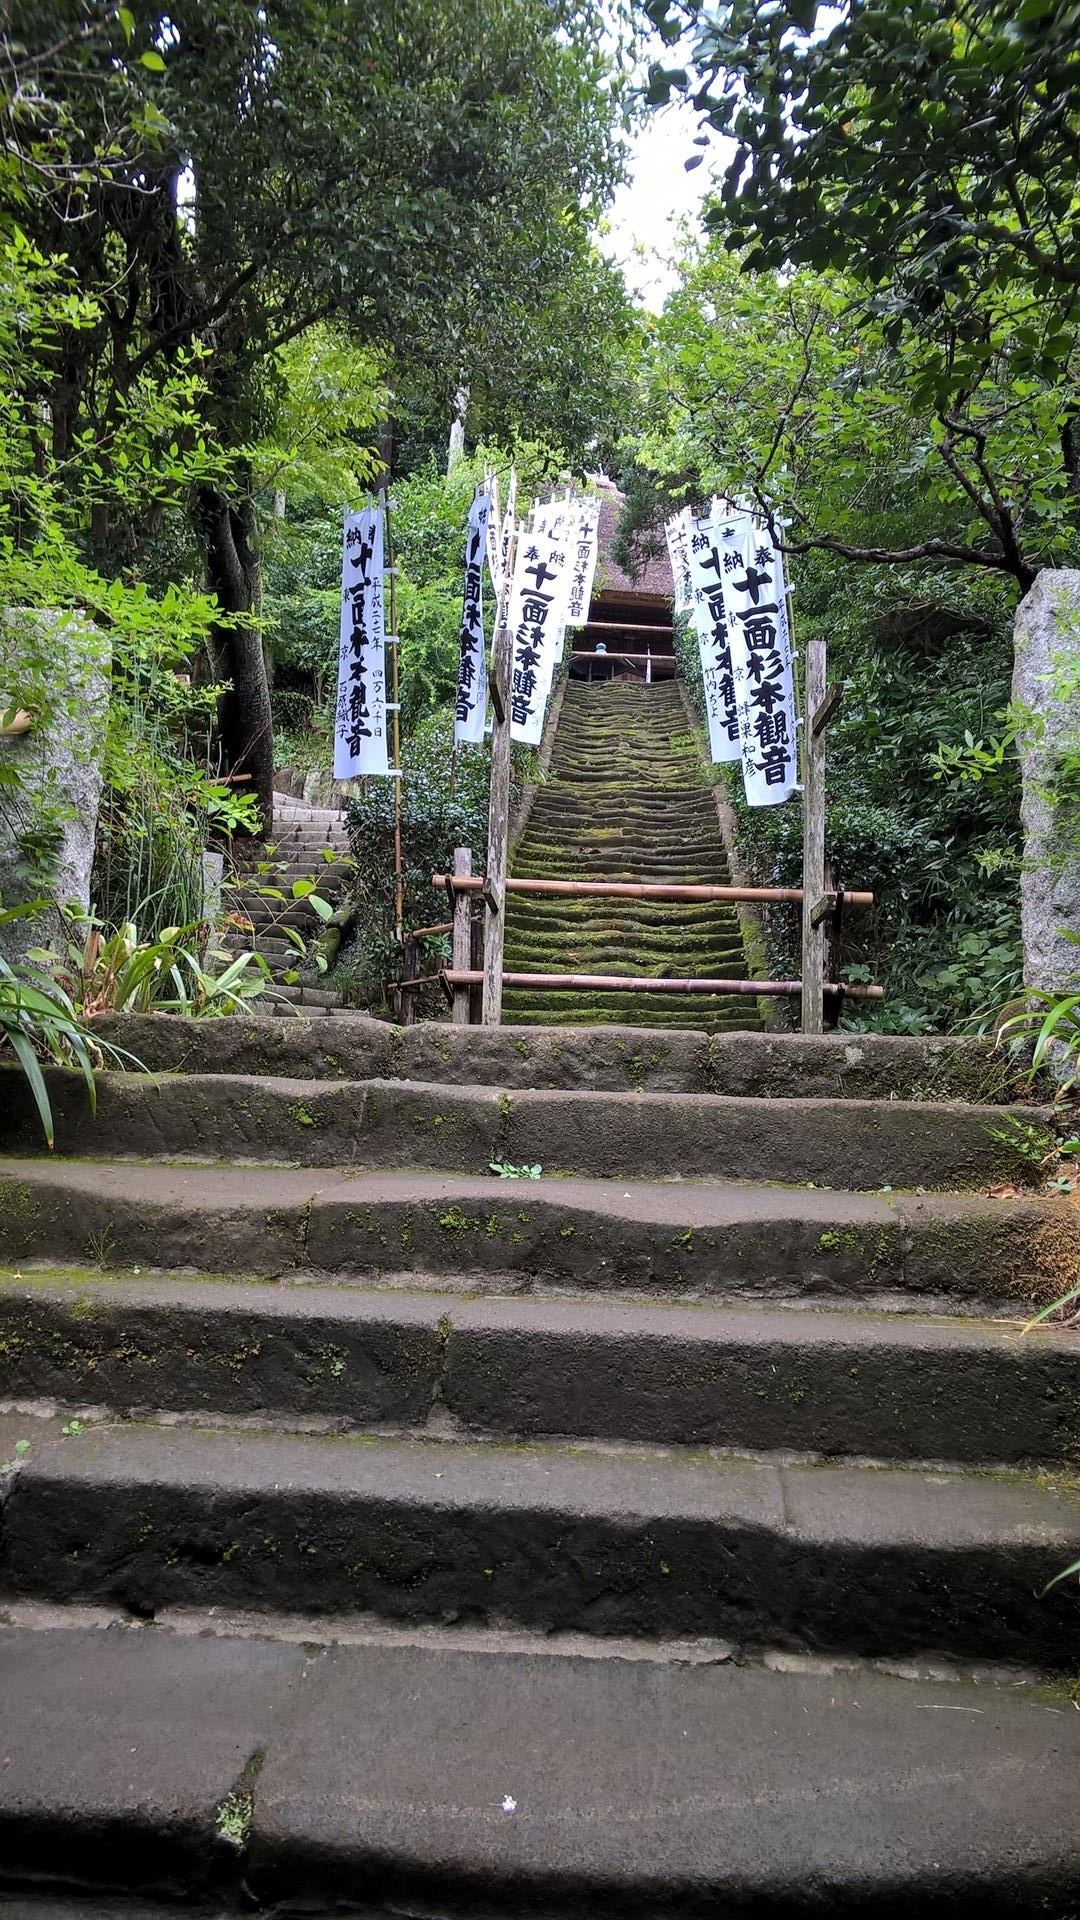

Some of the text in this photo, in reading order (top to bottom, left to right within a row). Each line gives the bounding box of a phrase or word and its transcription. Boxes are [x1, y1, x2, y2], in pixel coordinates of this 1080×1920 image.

[371, 669, 384, 737] 四万六千日
[732, 566, 791, 786] 十一面杉本観音
